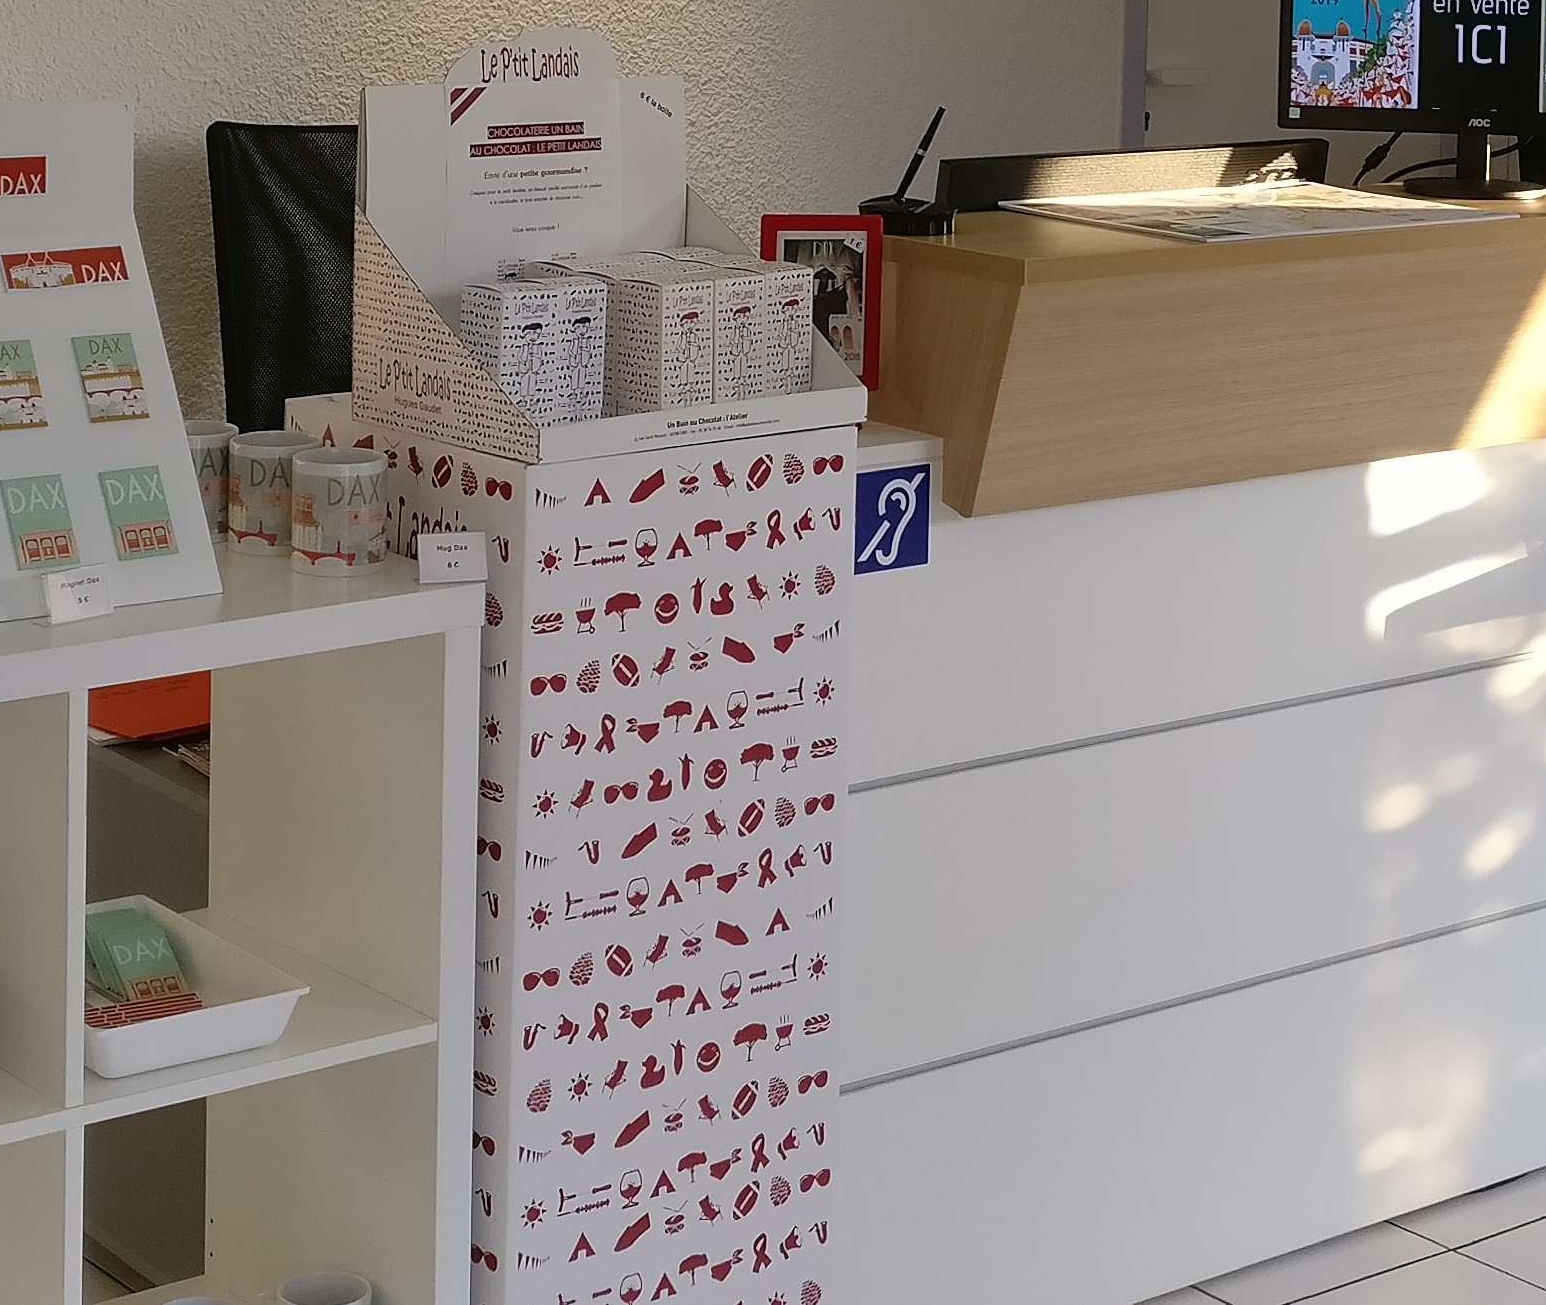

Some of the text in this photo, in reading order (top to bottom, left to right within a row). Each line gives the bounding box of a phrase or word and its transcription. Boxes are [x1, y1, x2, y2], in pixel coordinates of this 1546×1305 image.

[480, 46, 580, 83] Le P'tit Landais
[487, 123, 584, 139] CHOCOLATERIE UN BAIN
[1468, 118, 1491, 127] AOC
[470, 146, 482, 156] AU
[483, 143, 531, 155] CHOCOLAT
[536, 143, 547, 153] LE
[547, 142, 566, 152] PETIT
[567, 139, 602, 151] LANDAIS
[0, 171, 42, 196] DAX
[484, 171, 500, 179] Envie
[520, 169, 538, 178] petite
[541, 167, 582, 177] gourmandise
[81, 261, 125, 283] DAX
[88, 337, 123, 356] DAX
[379, 357, 391, 389] Le
[415, 365, 451, 401] Landais
[667, 421, 676, 429] Un
[698, 416, 722, 425] Chocolat
[190, 446, 230, 478] AX
[249, 455, 291, 488] DA
[6, 481, 67, 516] DAX
[104, 472, 164, 506] DAX
[327, 473, 380, 507] DAX
[436, 545, 452, 553] Mug
[87, 577, 100, 585] Dax
[112, 936, 171, 966] DAX
